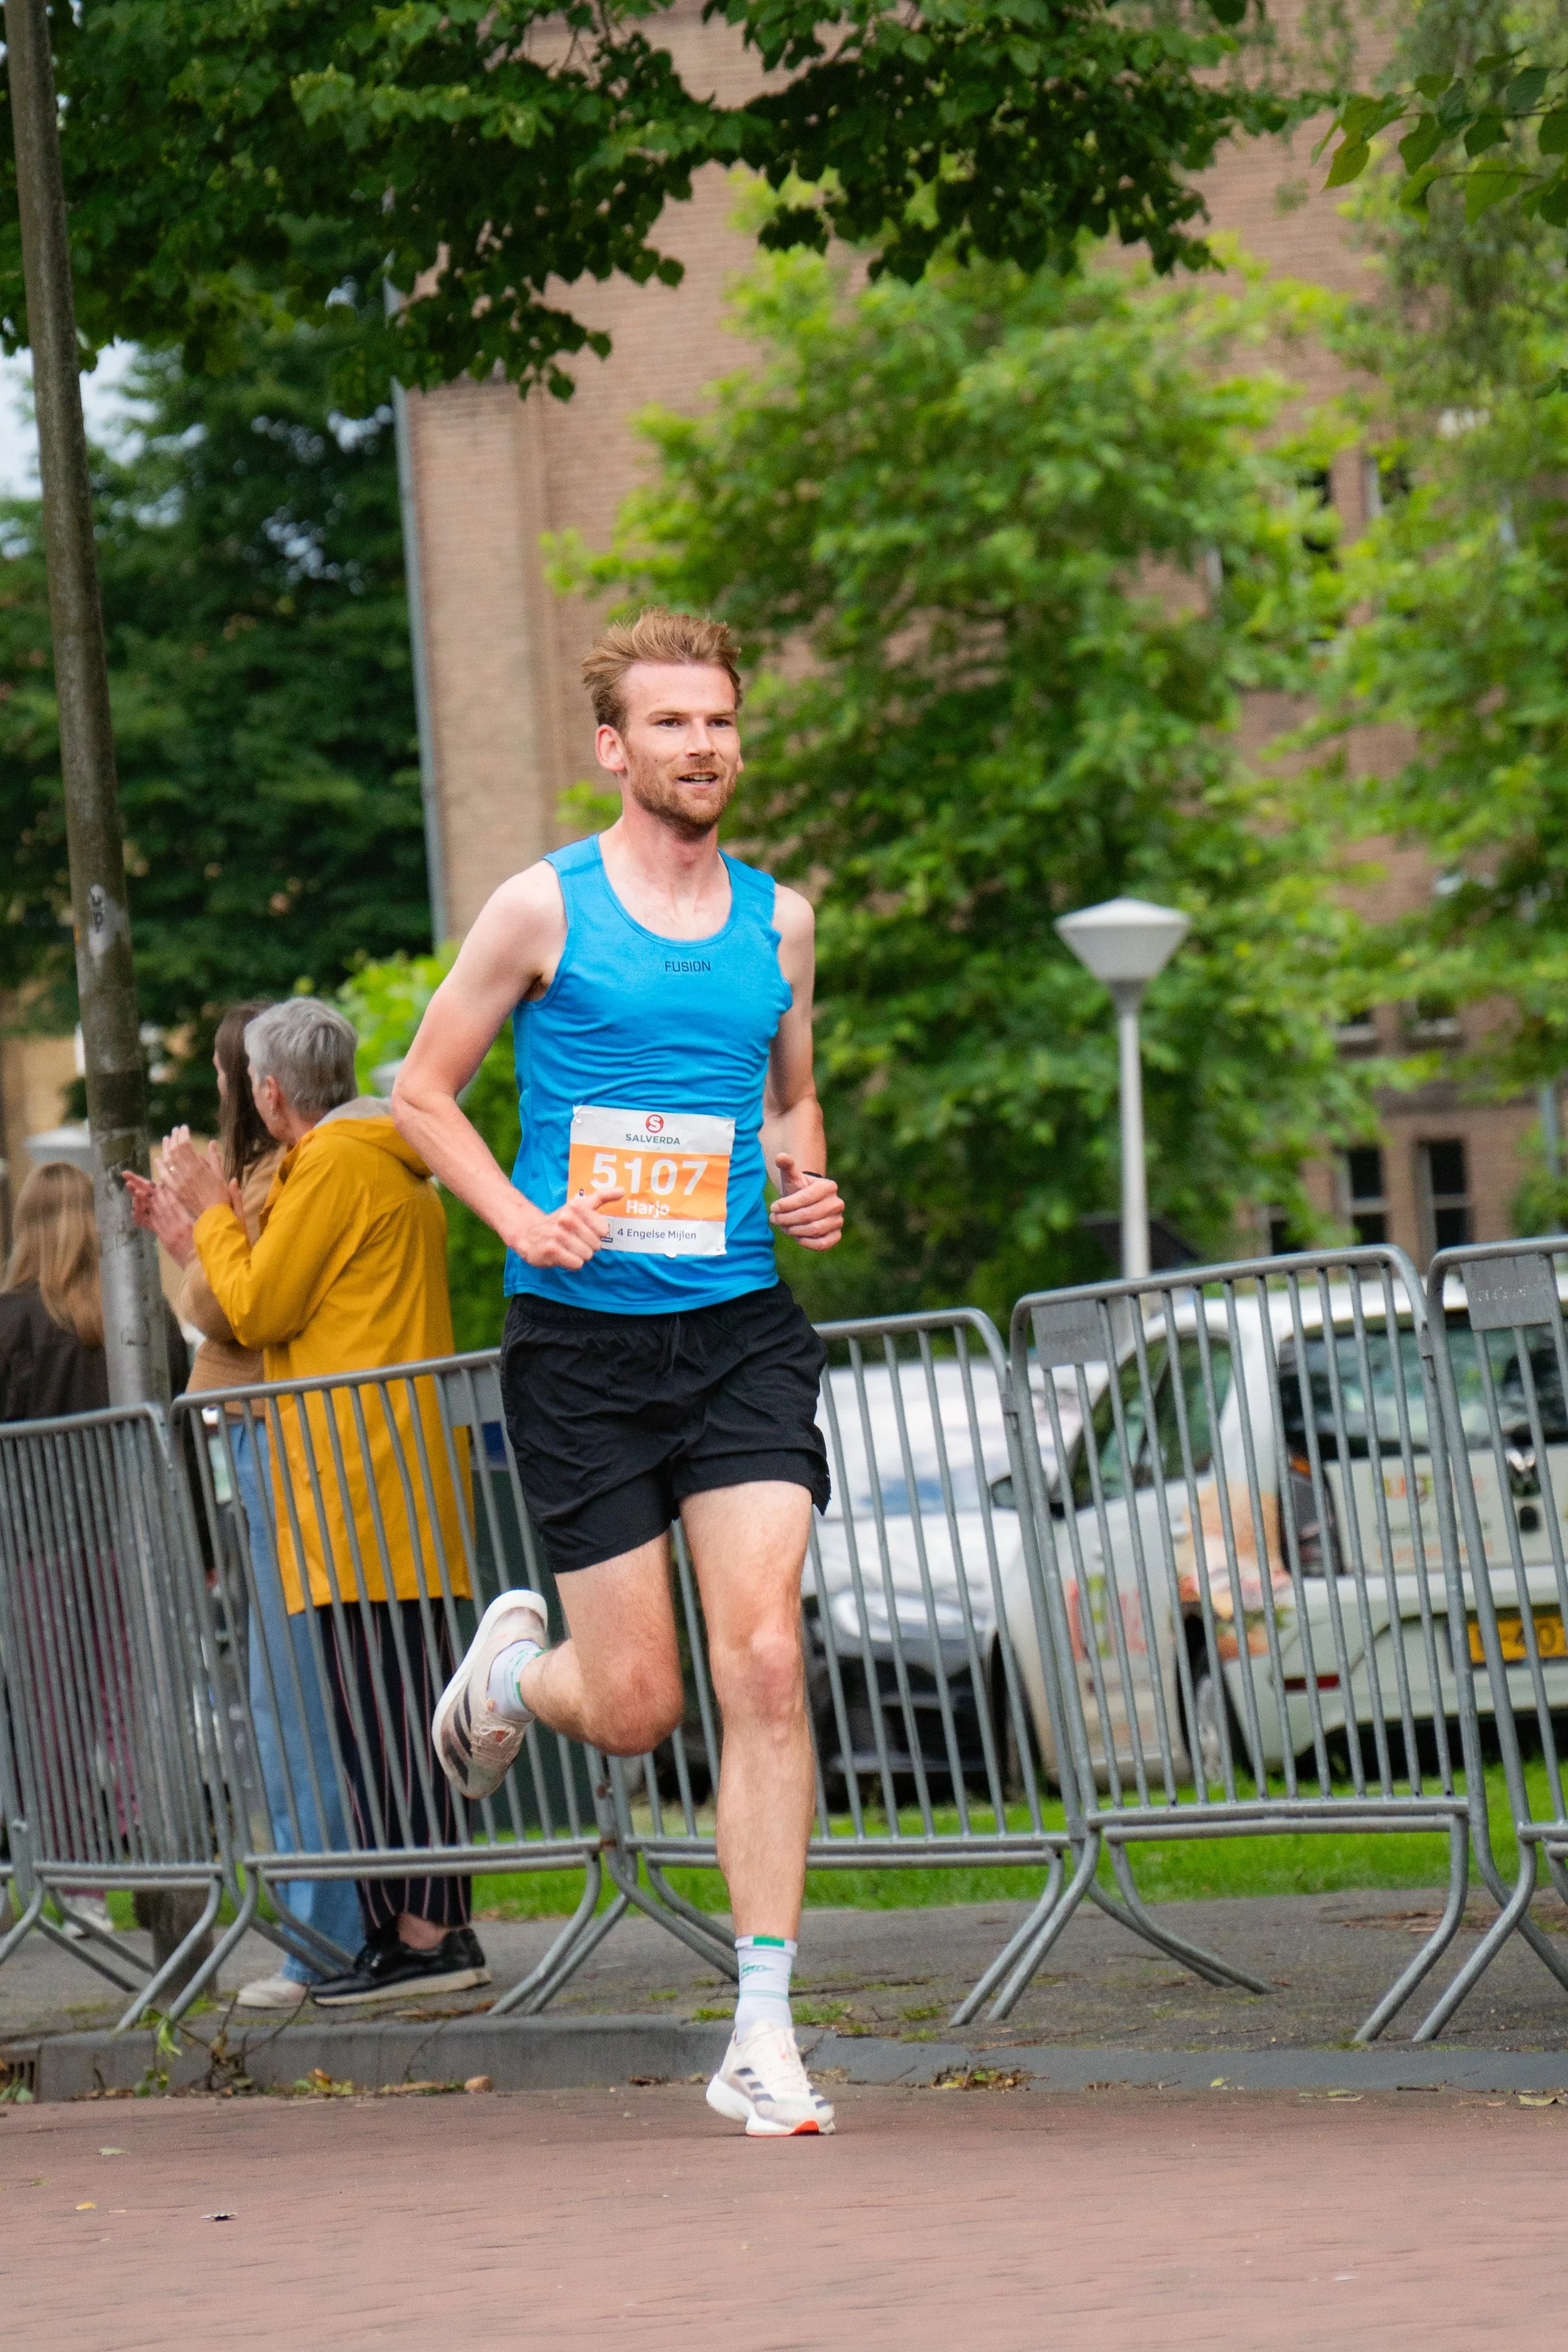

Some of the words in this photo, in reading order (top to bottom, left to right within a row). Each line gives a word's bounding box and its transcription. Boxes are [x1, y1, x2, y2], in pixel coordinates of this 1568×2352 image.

[665, 960, 711, 972] FUSION
[625, 1133, 681, 1145] SALVERDA
[590, 1153, 707, 1195] 5107
[626, 1199, 670, 1218] Harjo
[617, 1228, 624, 1236] 4
[627, 1229, 665, 1239] Engelse
[668, 1231, 696, 1241] Mijlen
